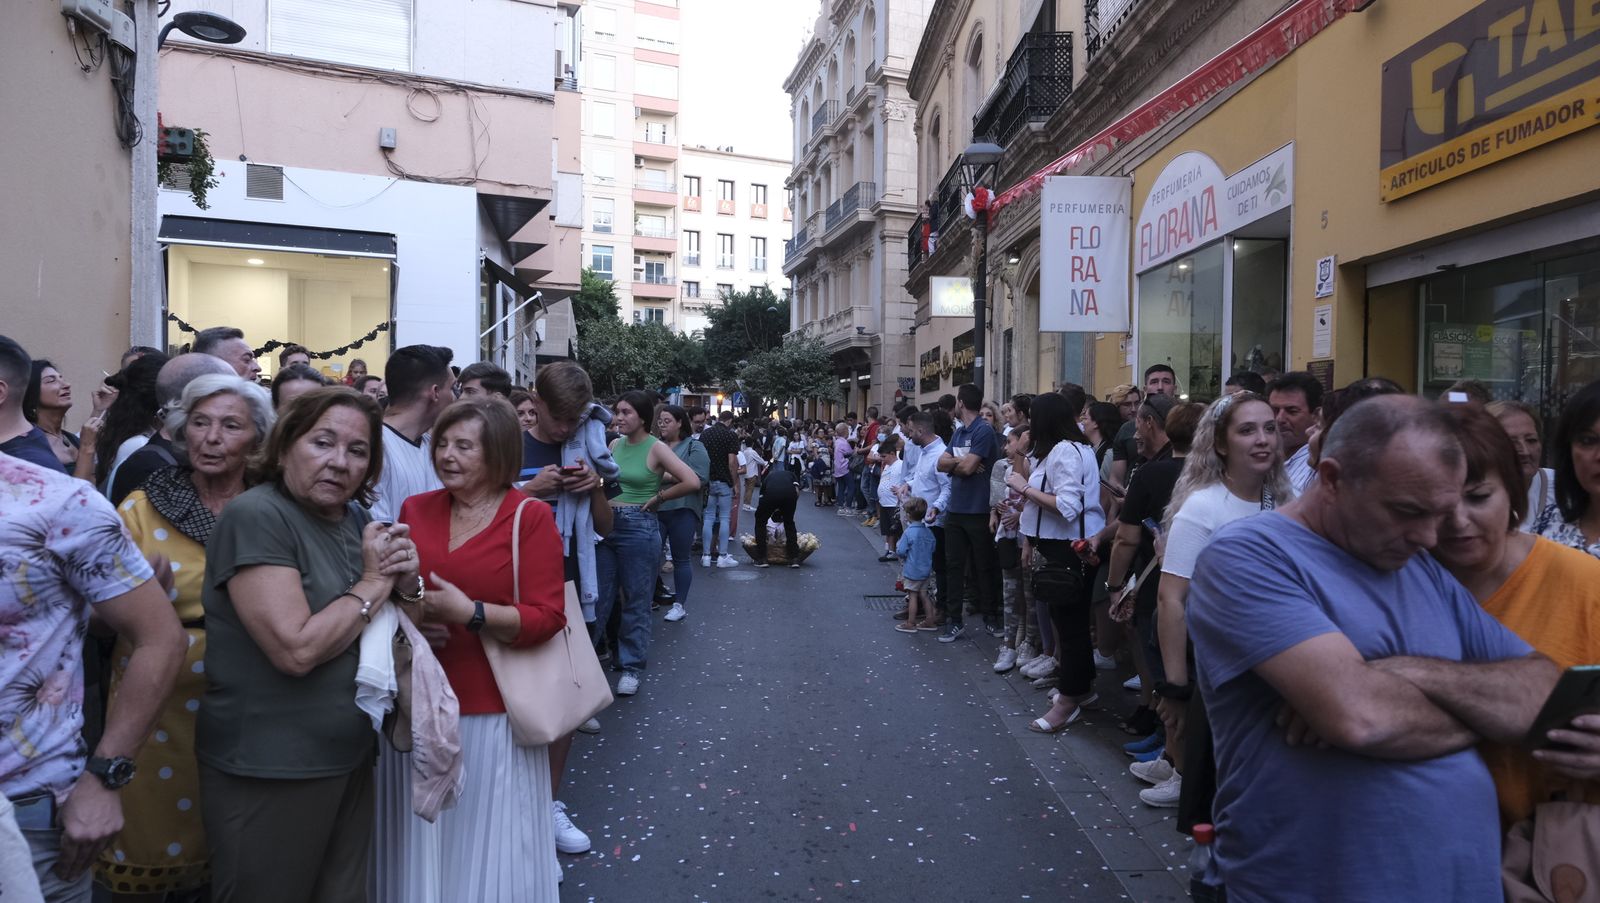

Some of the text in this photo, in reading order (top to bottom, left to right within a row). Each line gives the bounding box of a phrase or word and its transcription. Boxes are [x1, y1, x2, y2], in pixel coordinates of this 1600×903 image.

[1390, 147, 1465, 191] ARTÍCULOS
[1470, 137, 1490, 159] DE
[1495, 98, 1585, 149] FUMADOR
[1152, 164, 1202, 207] PERFUMERIA
[1227, 166, 1271, 201] CUIDAMOS
[1050, 203, 1125, 214] PERFUMERIA
[1237, 196, 1258, 216] DE TI
[1140, 185, 1218, 266] FLORANA
[1321, 210, 1329, 230] 5
[1070, 225, 1101, 250] FLO
[1071, 256, 1101, 283] RA
[940, 304, 974, 315] MOHS
[1069, 289, 1099, 316] NA
